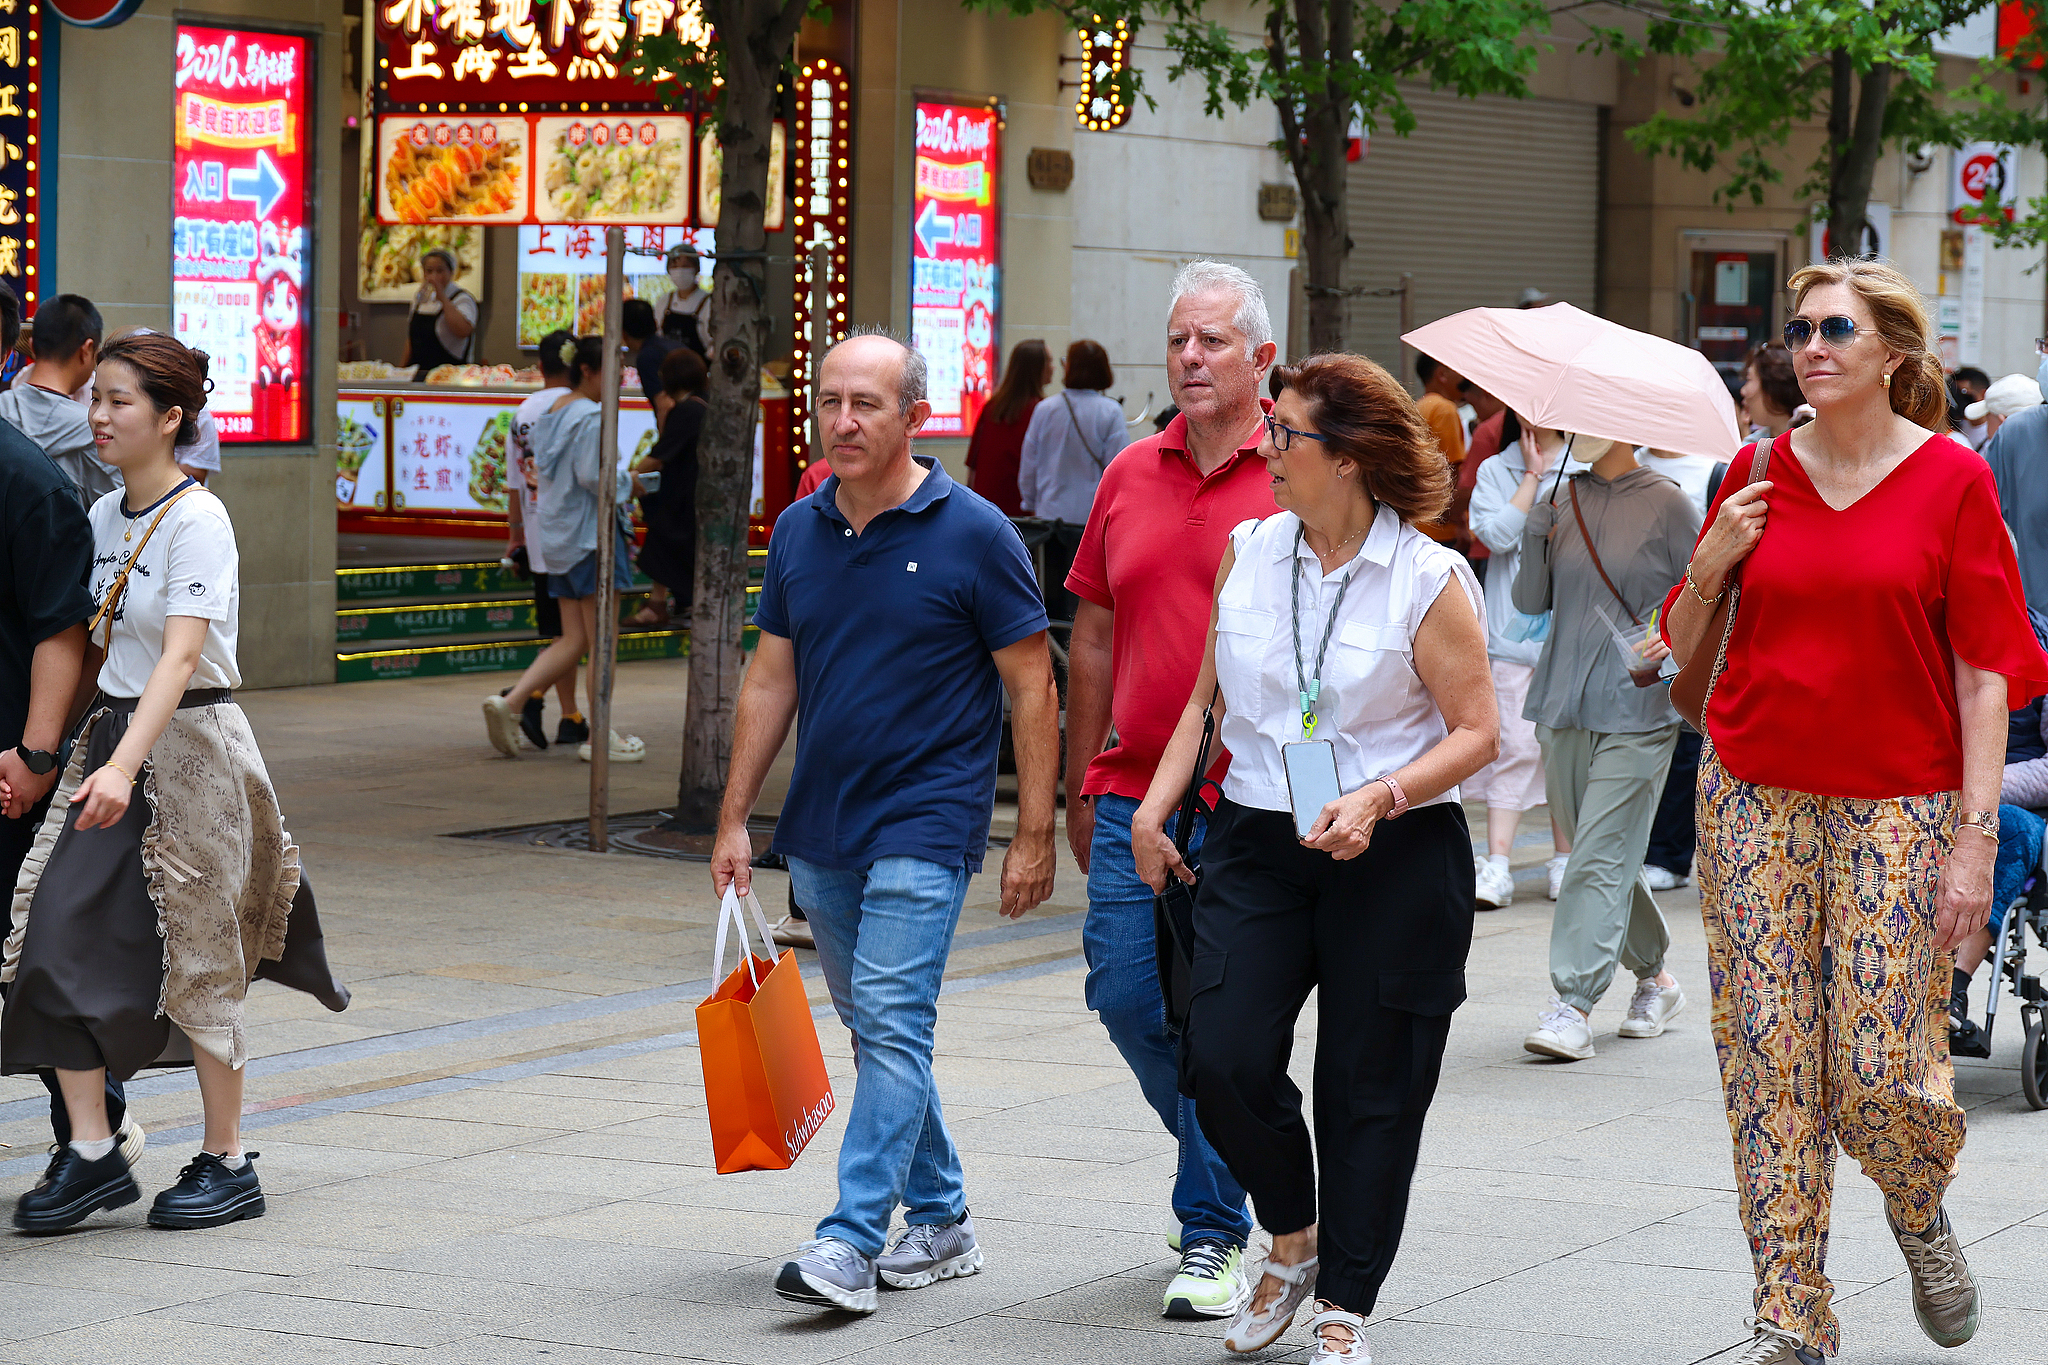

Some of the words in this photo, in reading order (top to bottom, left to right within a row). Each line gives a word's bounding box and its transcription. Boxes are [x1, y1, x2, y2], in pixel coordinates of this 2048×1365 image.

[186, 99, 286, 137] 美食街欢迎您
[182, 159, 224, 202] 入口
[1967, 162, 2001, 192] 24
[955, 213, 982, 248] 入口
[785, 1091, 833, 1161] Sulwhasoo
